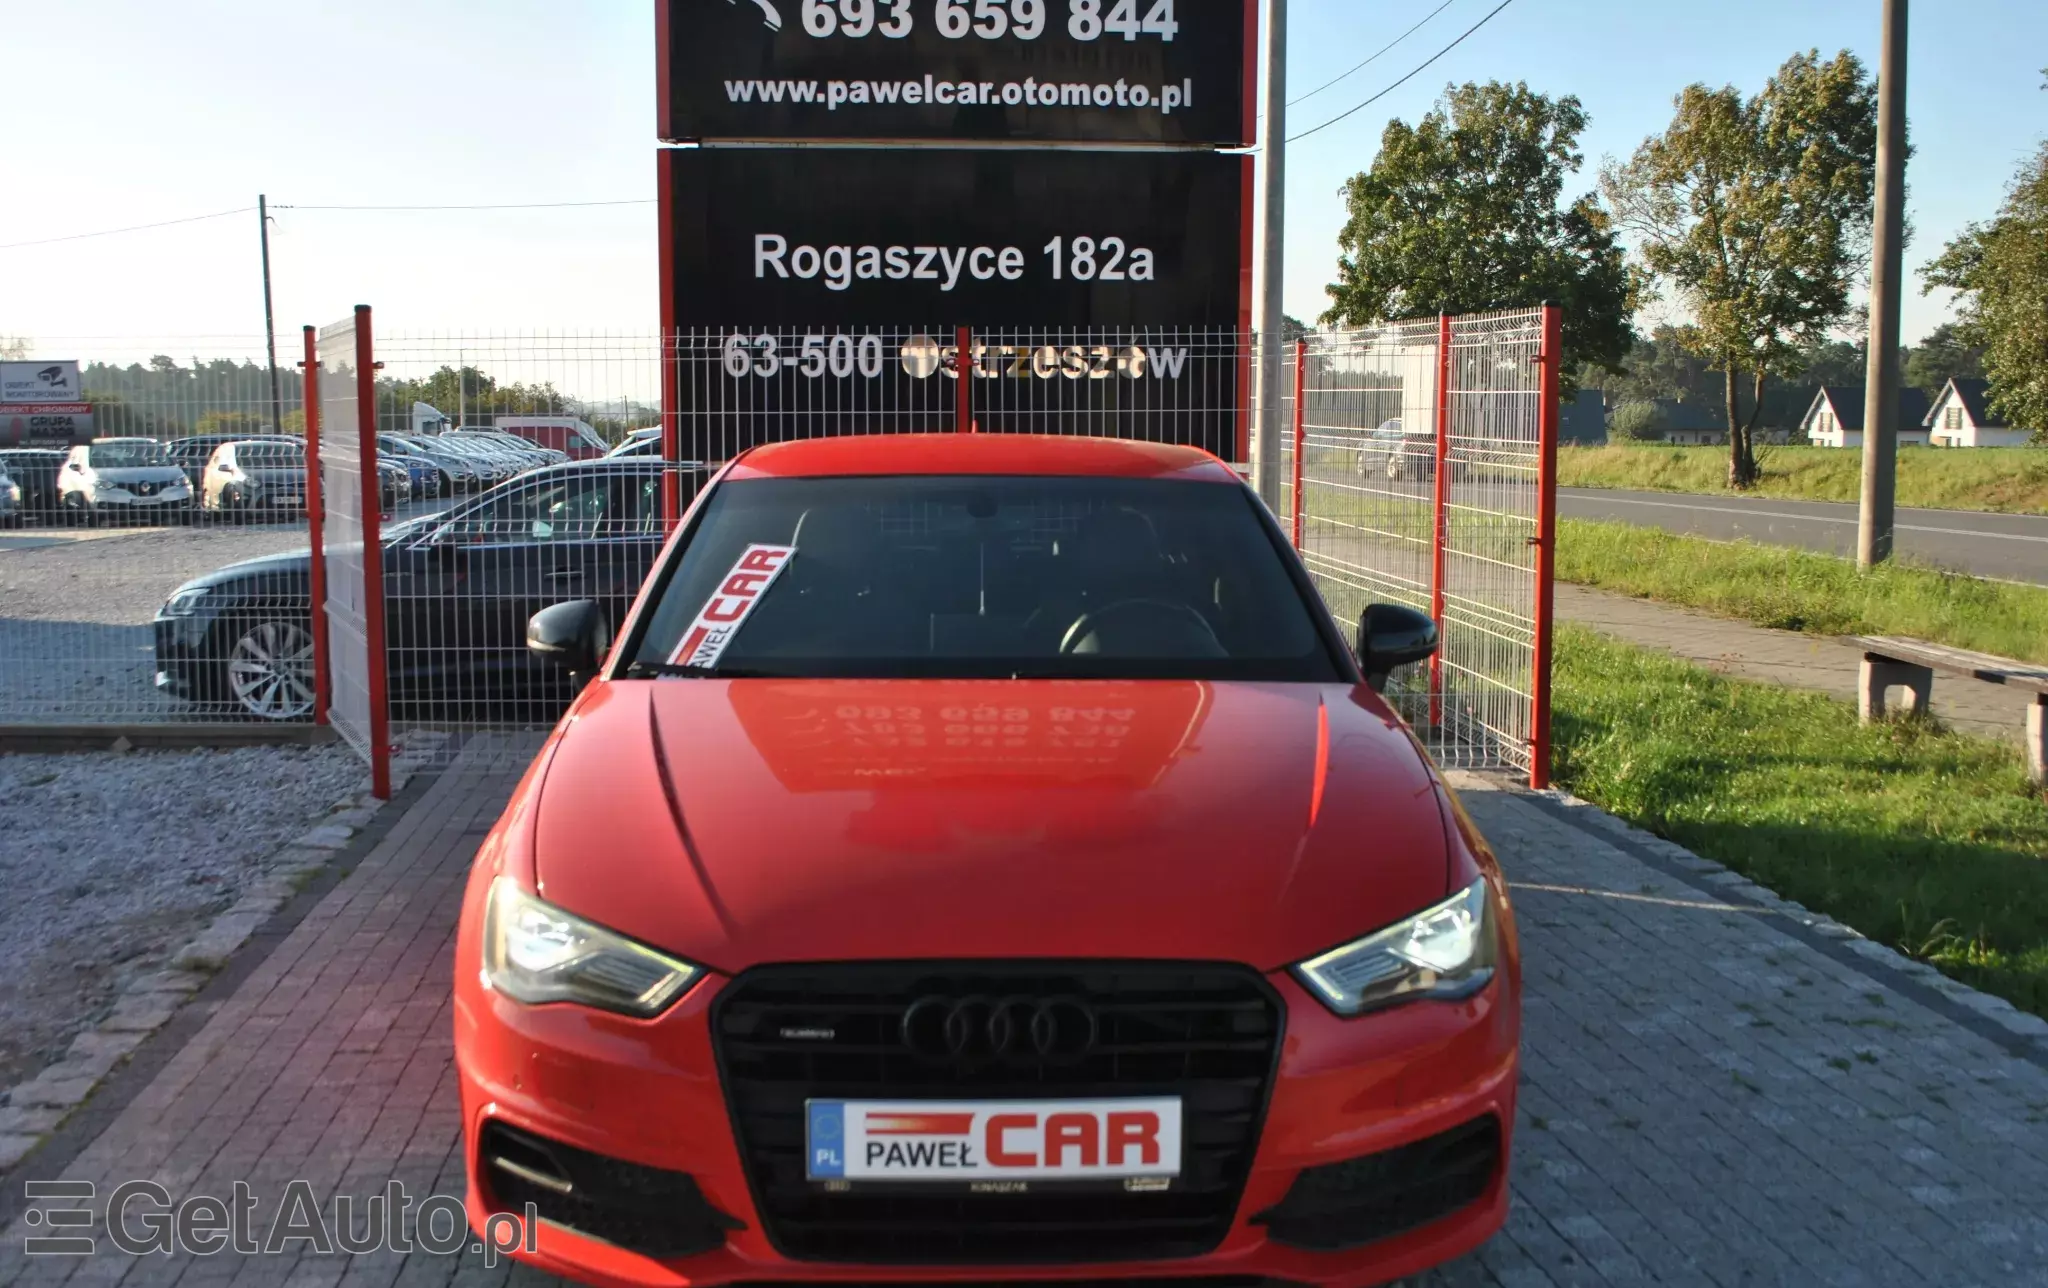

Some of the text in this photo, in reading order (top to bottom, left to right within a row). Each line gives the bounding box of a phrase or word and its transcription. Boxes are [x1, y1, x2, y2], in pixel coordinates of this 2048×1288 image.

[801, 0, 1179, 42] 693 659 844
[724, 74, 1192, 114] www.pawelcar.otomoto.pl
[755, 233, 1155, 291] Rogaszyce 182a
[723, 333, 883, 379] 63-500
[30, 416, 75, 426] GRUPA
[703, 549, 787, 622] CAR
[815, 1149, 841, 1167] PL
[866, 1111, 1161, 1168] PAWEŁ CAR
